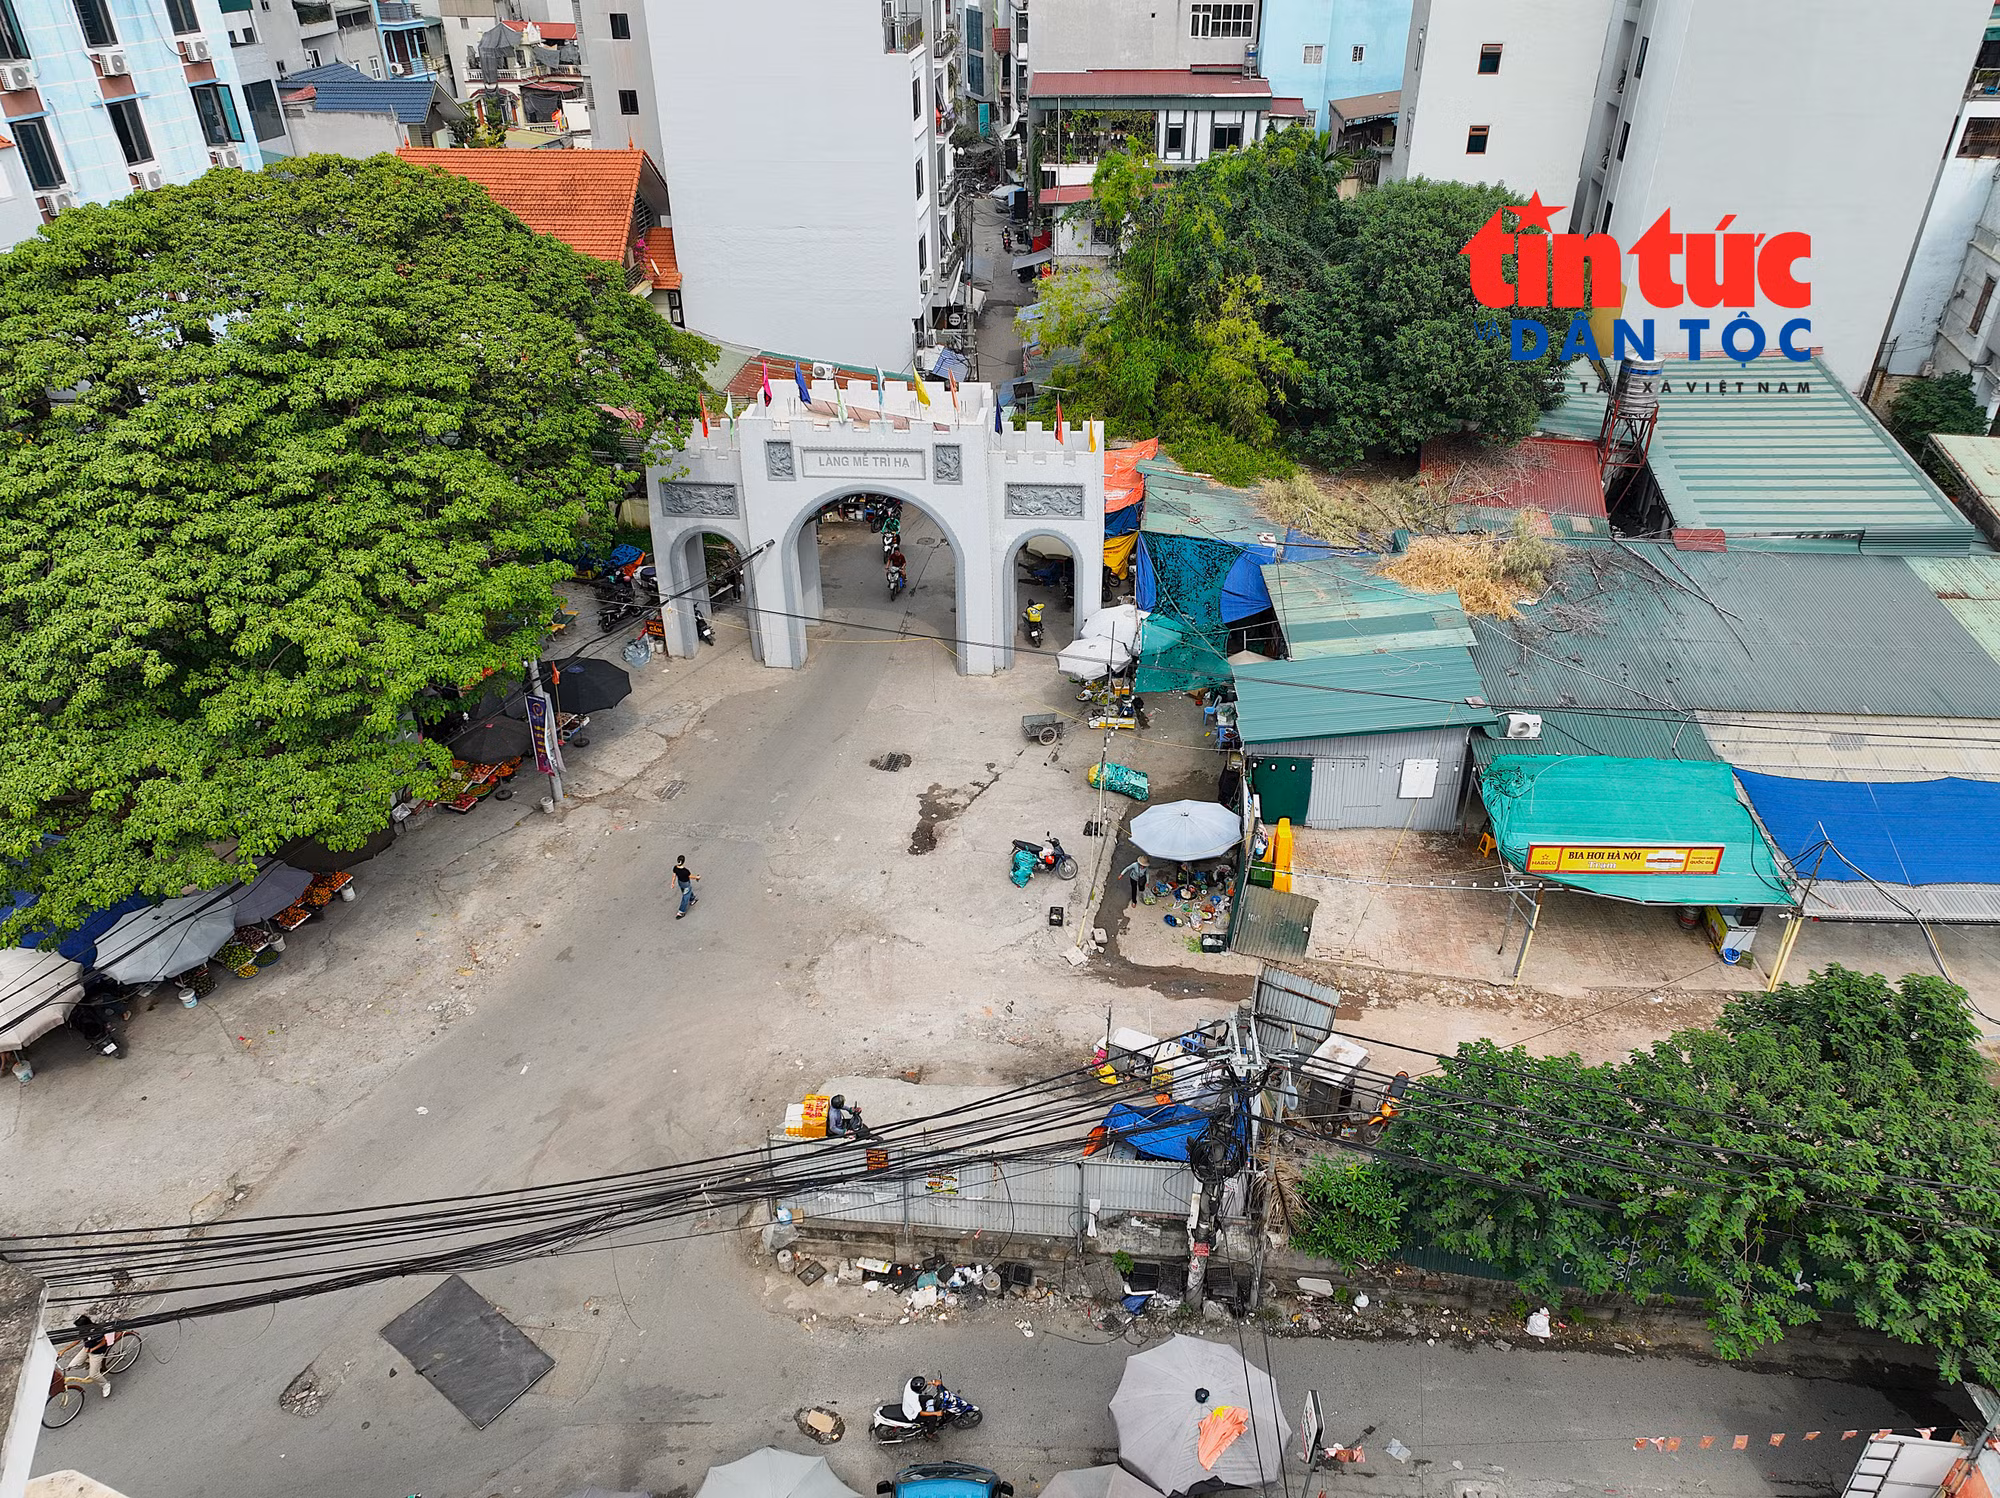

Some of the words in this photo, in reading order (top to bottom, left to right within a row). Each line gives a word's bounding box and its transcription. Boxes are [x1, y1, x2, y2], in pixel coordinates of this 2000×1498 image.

[818, 453, 850, 467] LÀNG
[872, 453, 891, 467] TRÌ
[893, 457, 910, 469] HẠ
[1567, 851, 1585, 860] BIA
[1606, 849, 1621, 860] HÀ
[1622, 850, 1642, 862] NỘI
